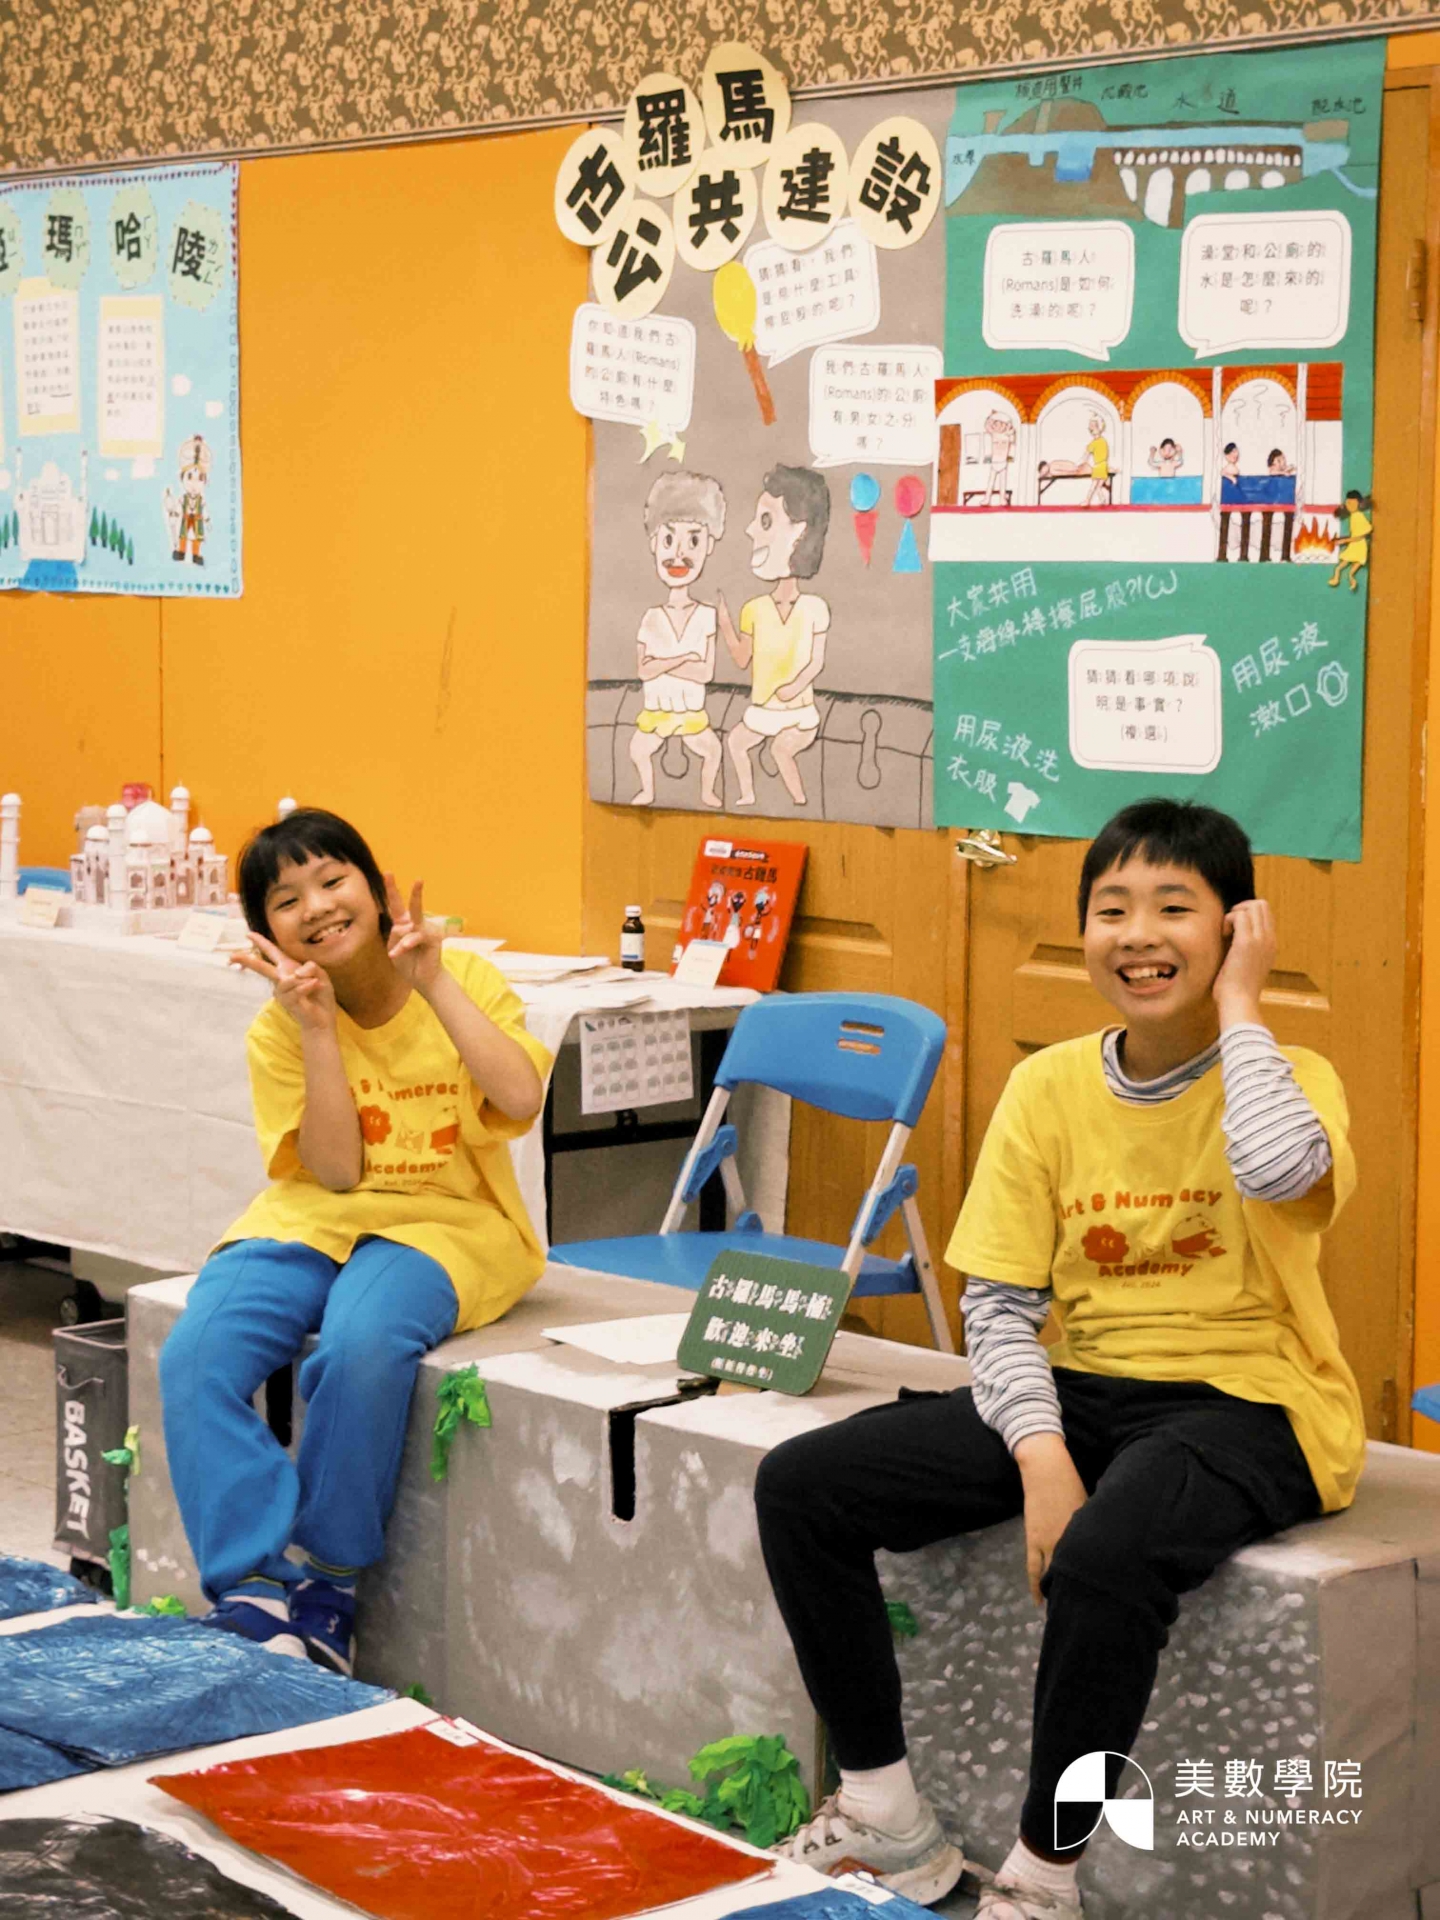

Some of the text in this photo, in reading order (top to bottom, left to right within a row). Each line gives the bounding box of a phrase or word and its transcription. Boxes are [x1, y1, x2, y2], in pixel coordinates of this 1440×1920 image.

[566, 69, 775, 235] 古羅馬
[607, 137, 931, 302] 公共建設
[1022, 249, 1091, 266] 古羅馬人
[947, 567, 1037, 627] 大家共用
[1231, 621, 1328, 694] 用尿液
[946, 754, 997, 803] 衣服
[953, 714, 1060, 783] 用尿液洗
[1099, 1260, 1194, 1277] Academy
[64, 1400, 91, 1540] BASKET
